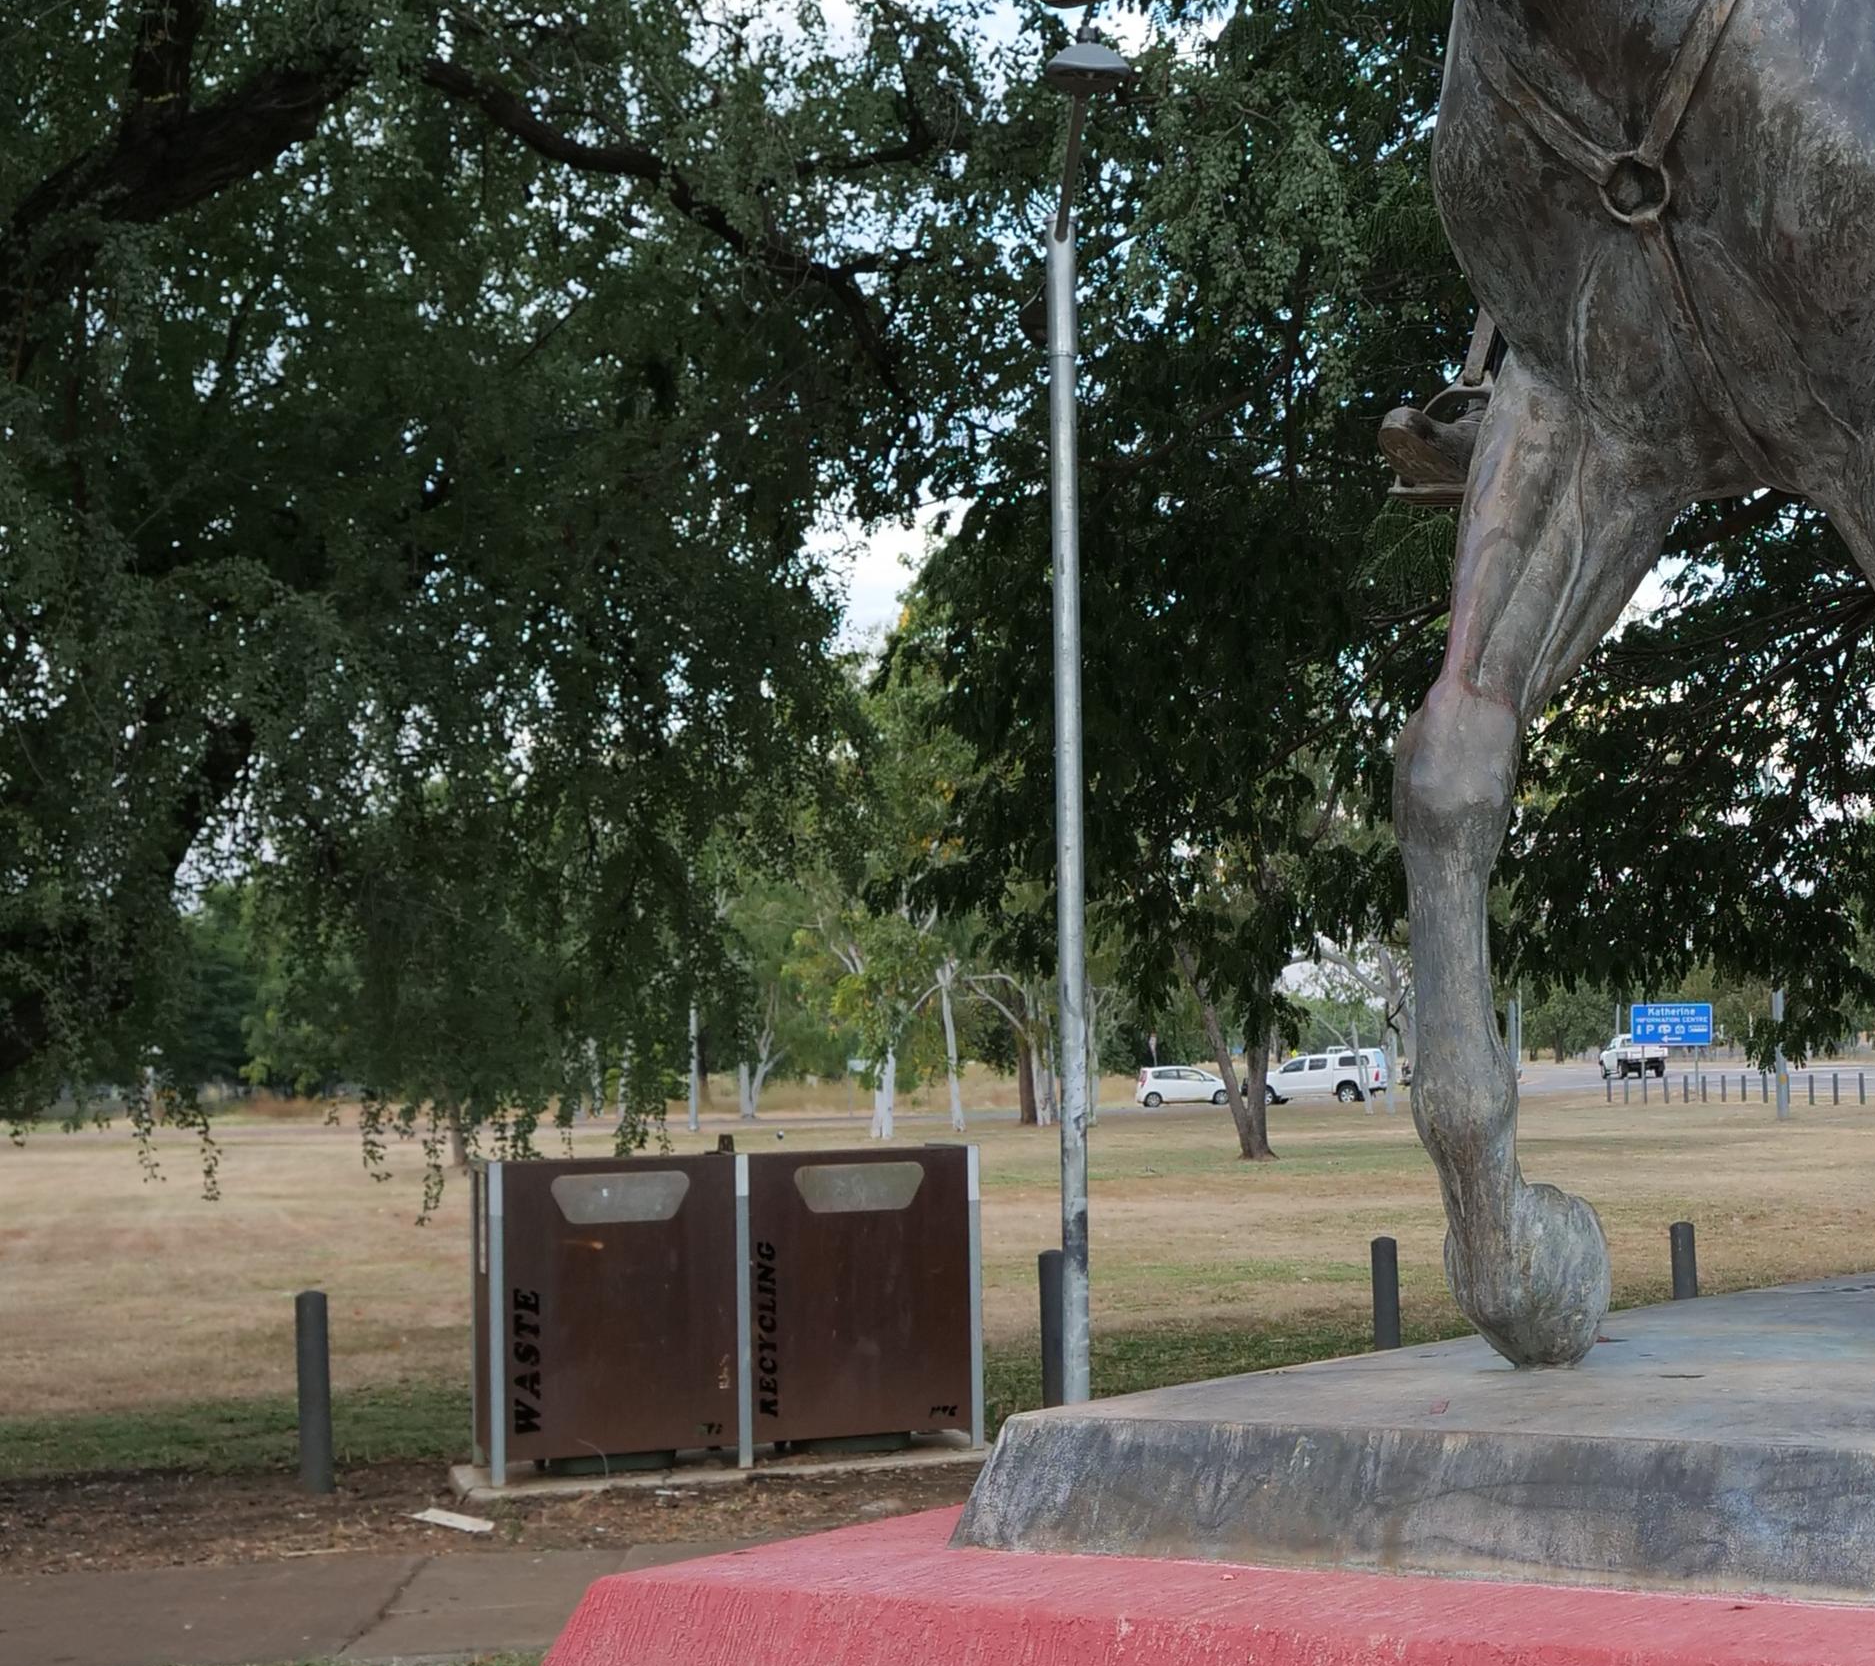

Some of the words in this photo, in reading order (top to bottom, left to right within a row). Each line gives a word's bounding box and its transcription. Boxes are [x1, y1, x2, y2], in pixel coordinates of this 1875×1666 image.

[1647, 1007, 1696, 1016] Katherine
[513, 1287, 541, 1434] WASTE
[756, 1241, 779, 1418] RECYCLING
